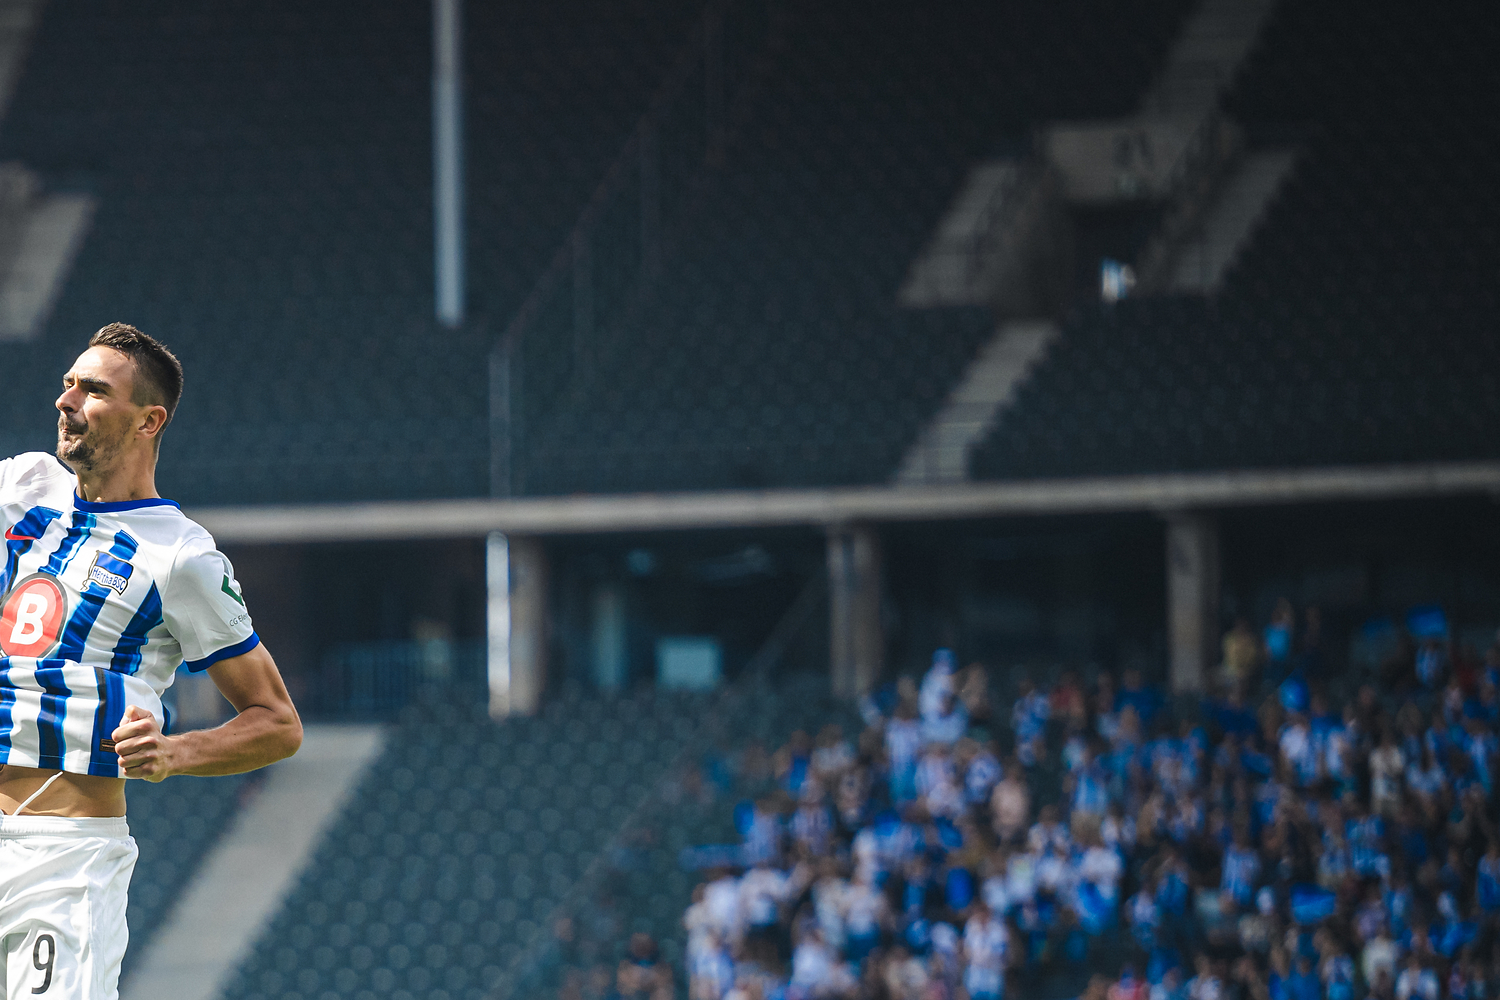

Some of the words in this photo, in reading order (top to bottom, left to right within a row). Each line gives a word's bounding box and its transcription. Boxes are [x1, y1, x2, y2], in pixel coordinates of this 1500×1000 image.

[92, 567, 113, 585] Hertha
[111, 576, 126, 591] BSC
[9, 592, 48, 645] B
[229, 617, 239, 627] CG
[31, 933, 56, 994] 9
